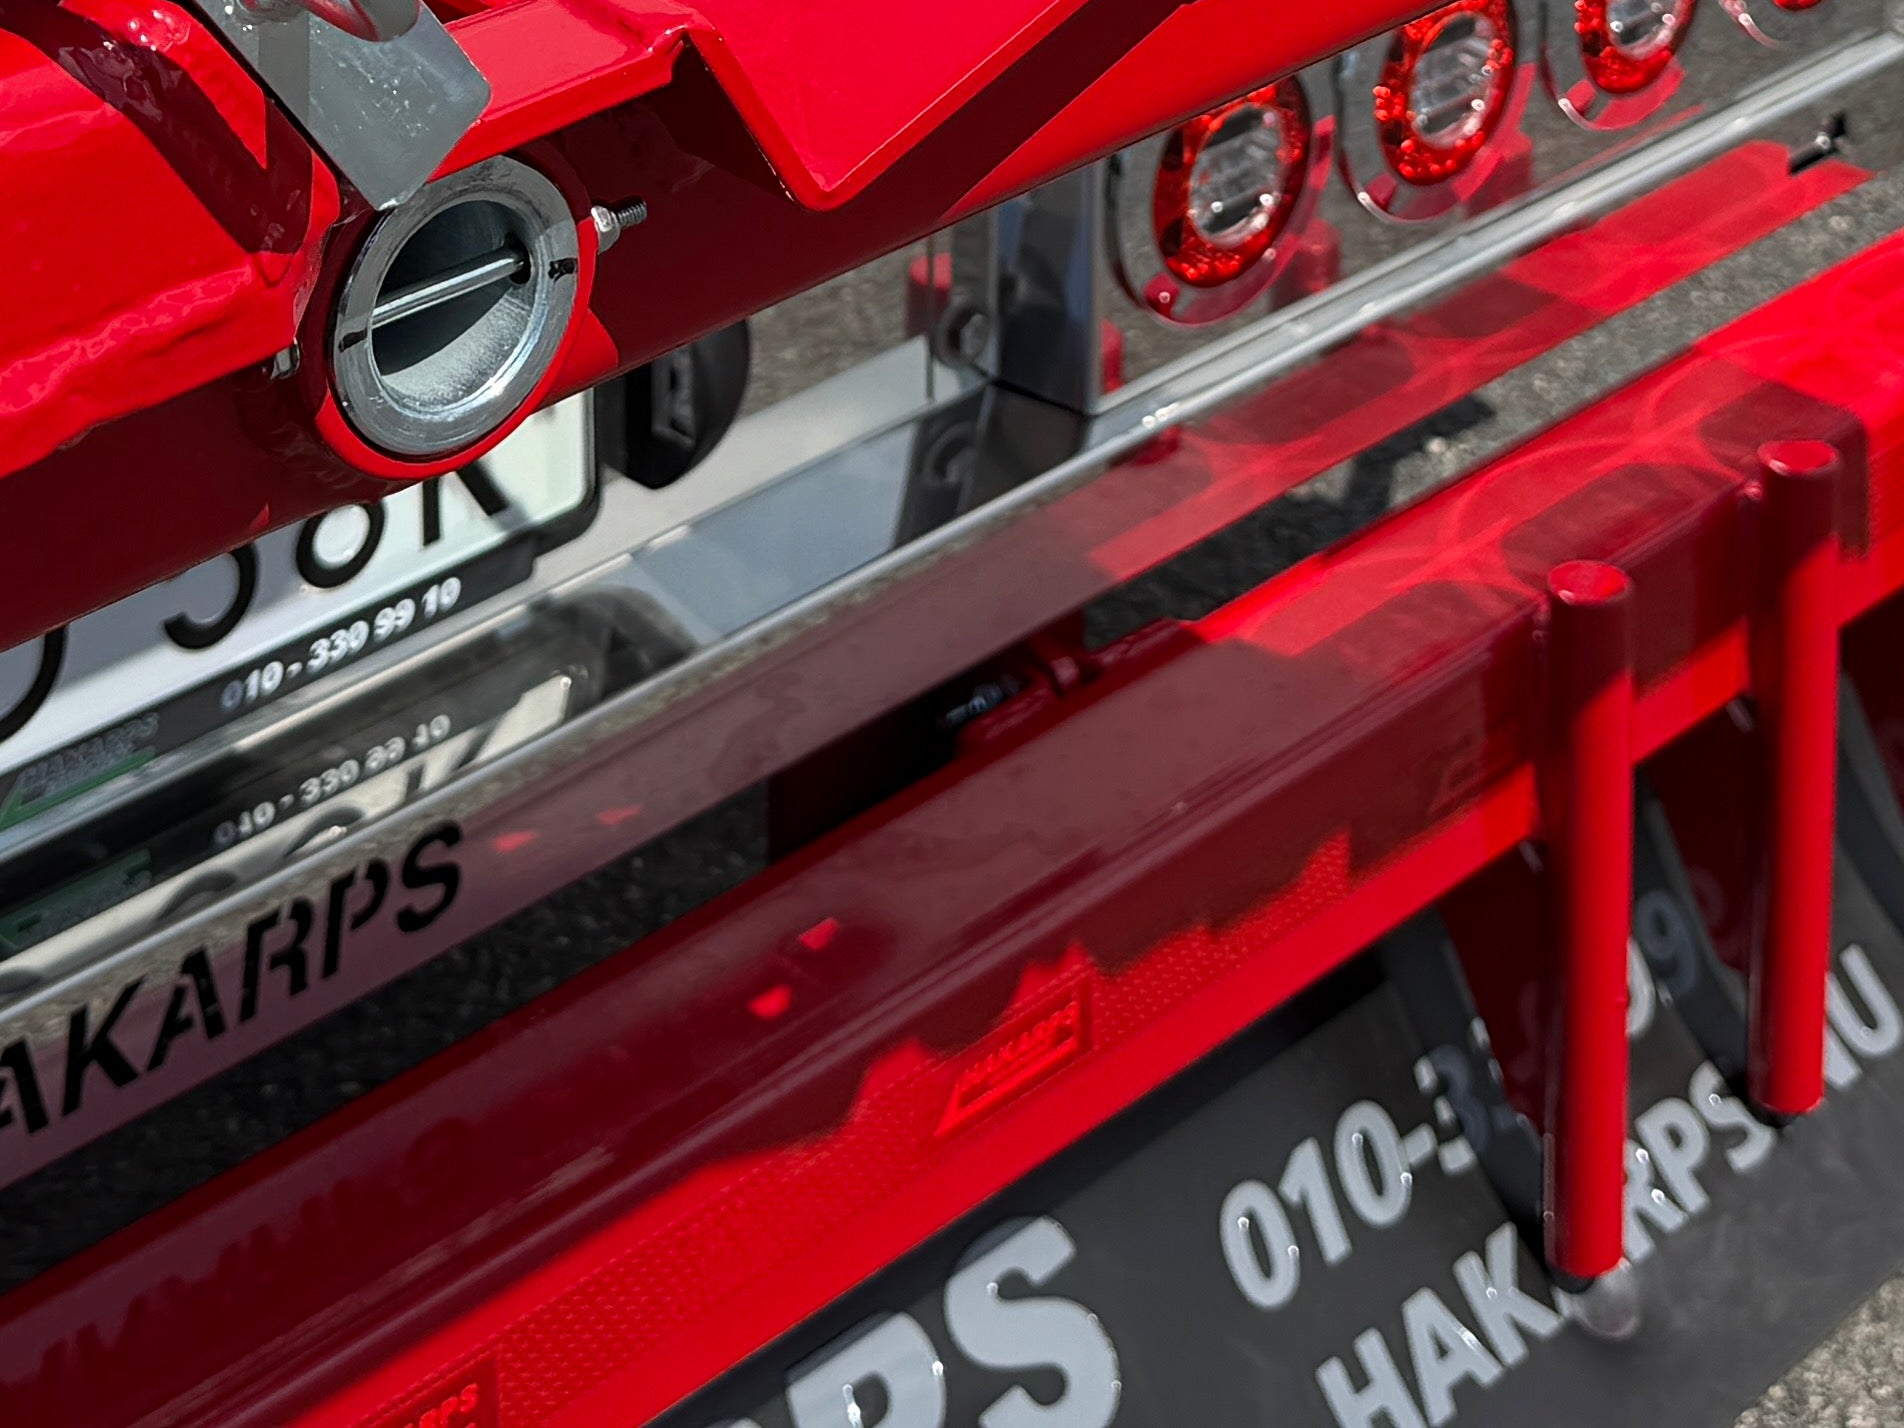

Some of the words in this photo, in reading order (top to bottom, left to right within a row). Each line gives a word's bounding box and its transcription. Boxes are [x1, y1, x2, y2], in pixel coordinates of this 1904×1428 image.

[221, 660, 284, 712] 010
[306, 619, 369, 674] 330
[373, 598, 416, 642] 99
[421, 576, 462, 619] 10
